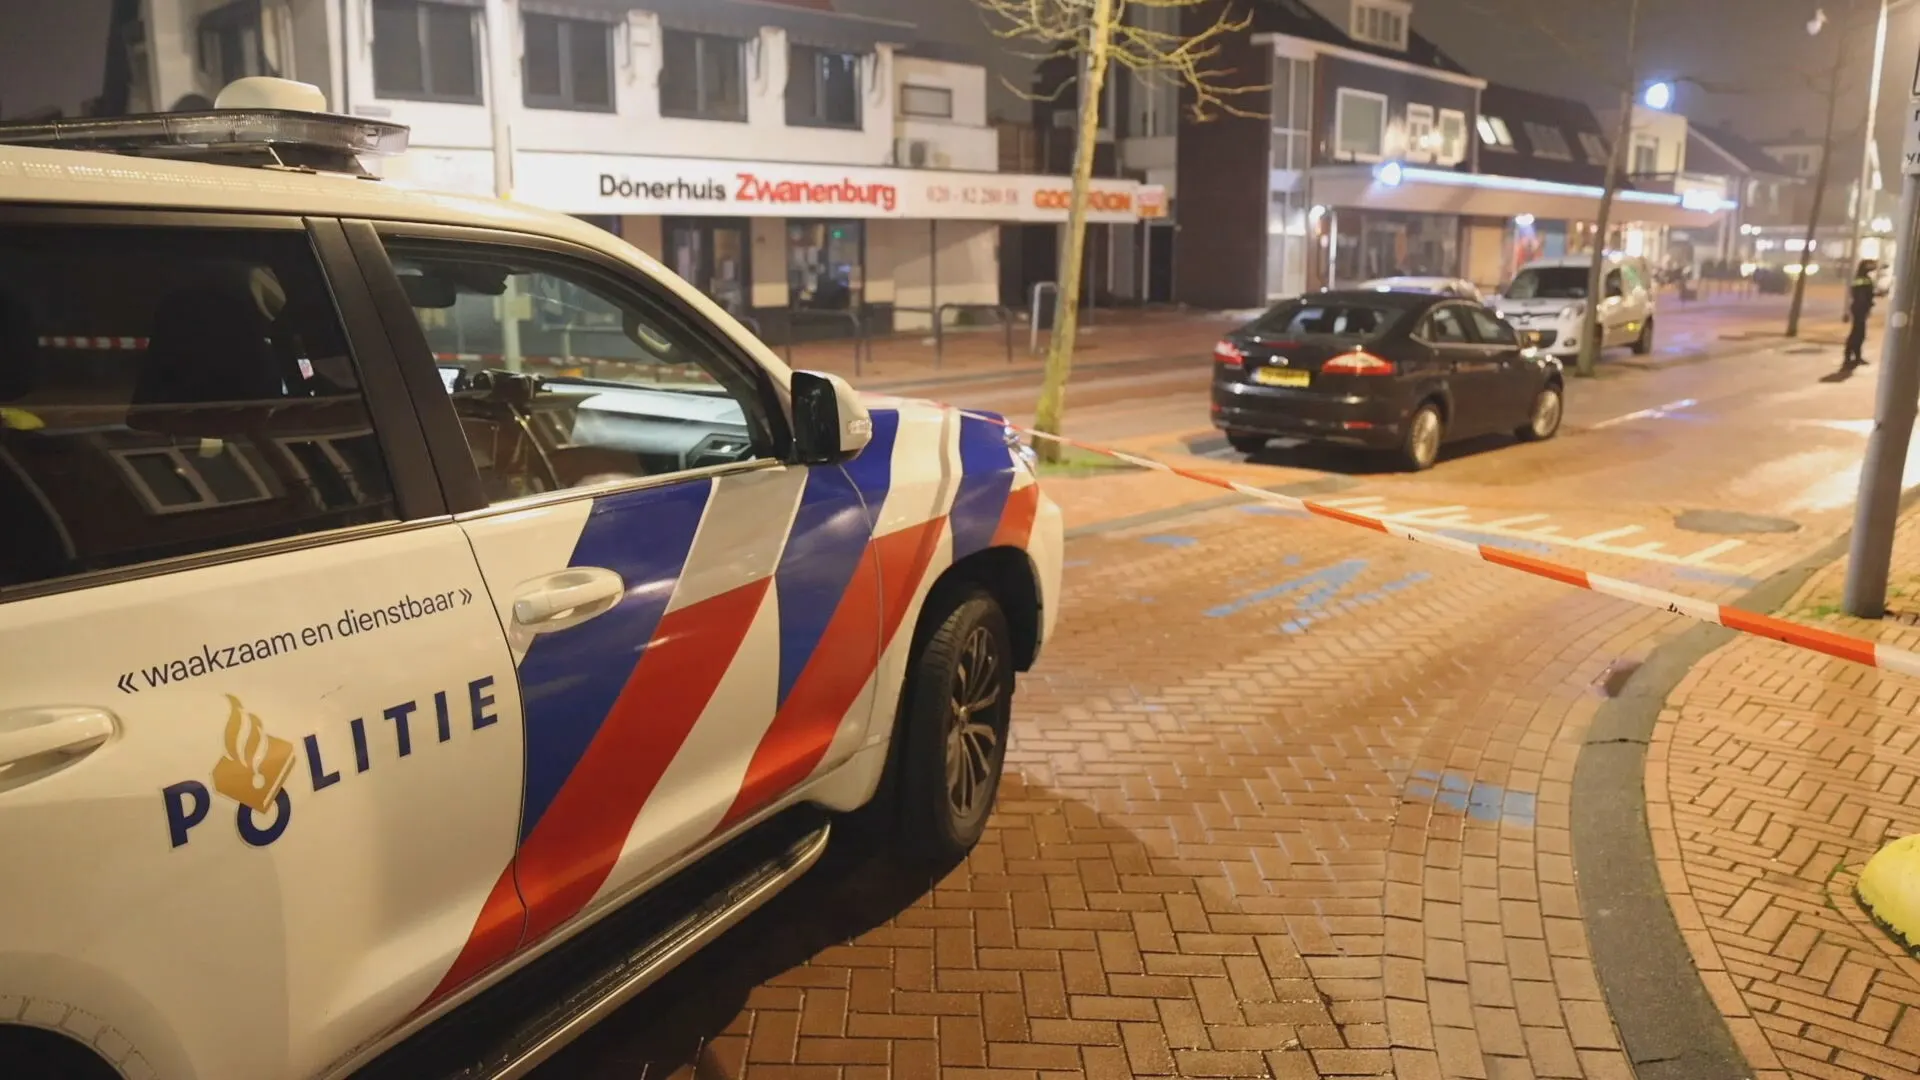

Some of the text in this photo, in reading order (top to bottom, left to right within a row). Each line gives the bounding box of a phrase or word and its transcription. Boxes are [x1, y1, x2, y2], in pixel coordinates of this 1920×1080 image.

[599, 172, 726, 200] Dönerhuis
[735, 173, 896, 211] Zwanenburg
[141, 631, 298, 688] waakzaam
[301, 621, 334, 647] en
[336, 589, 456, 638] dienstbaar
[162, 675, 499, 849] POLITIE
